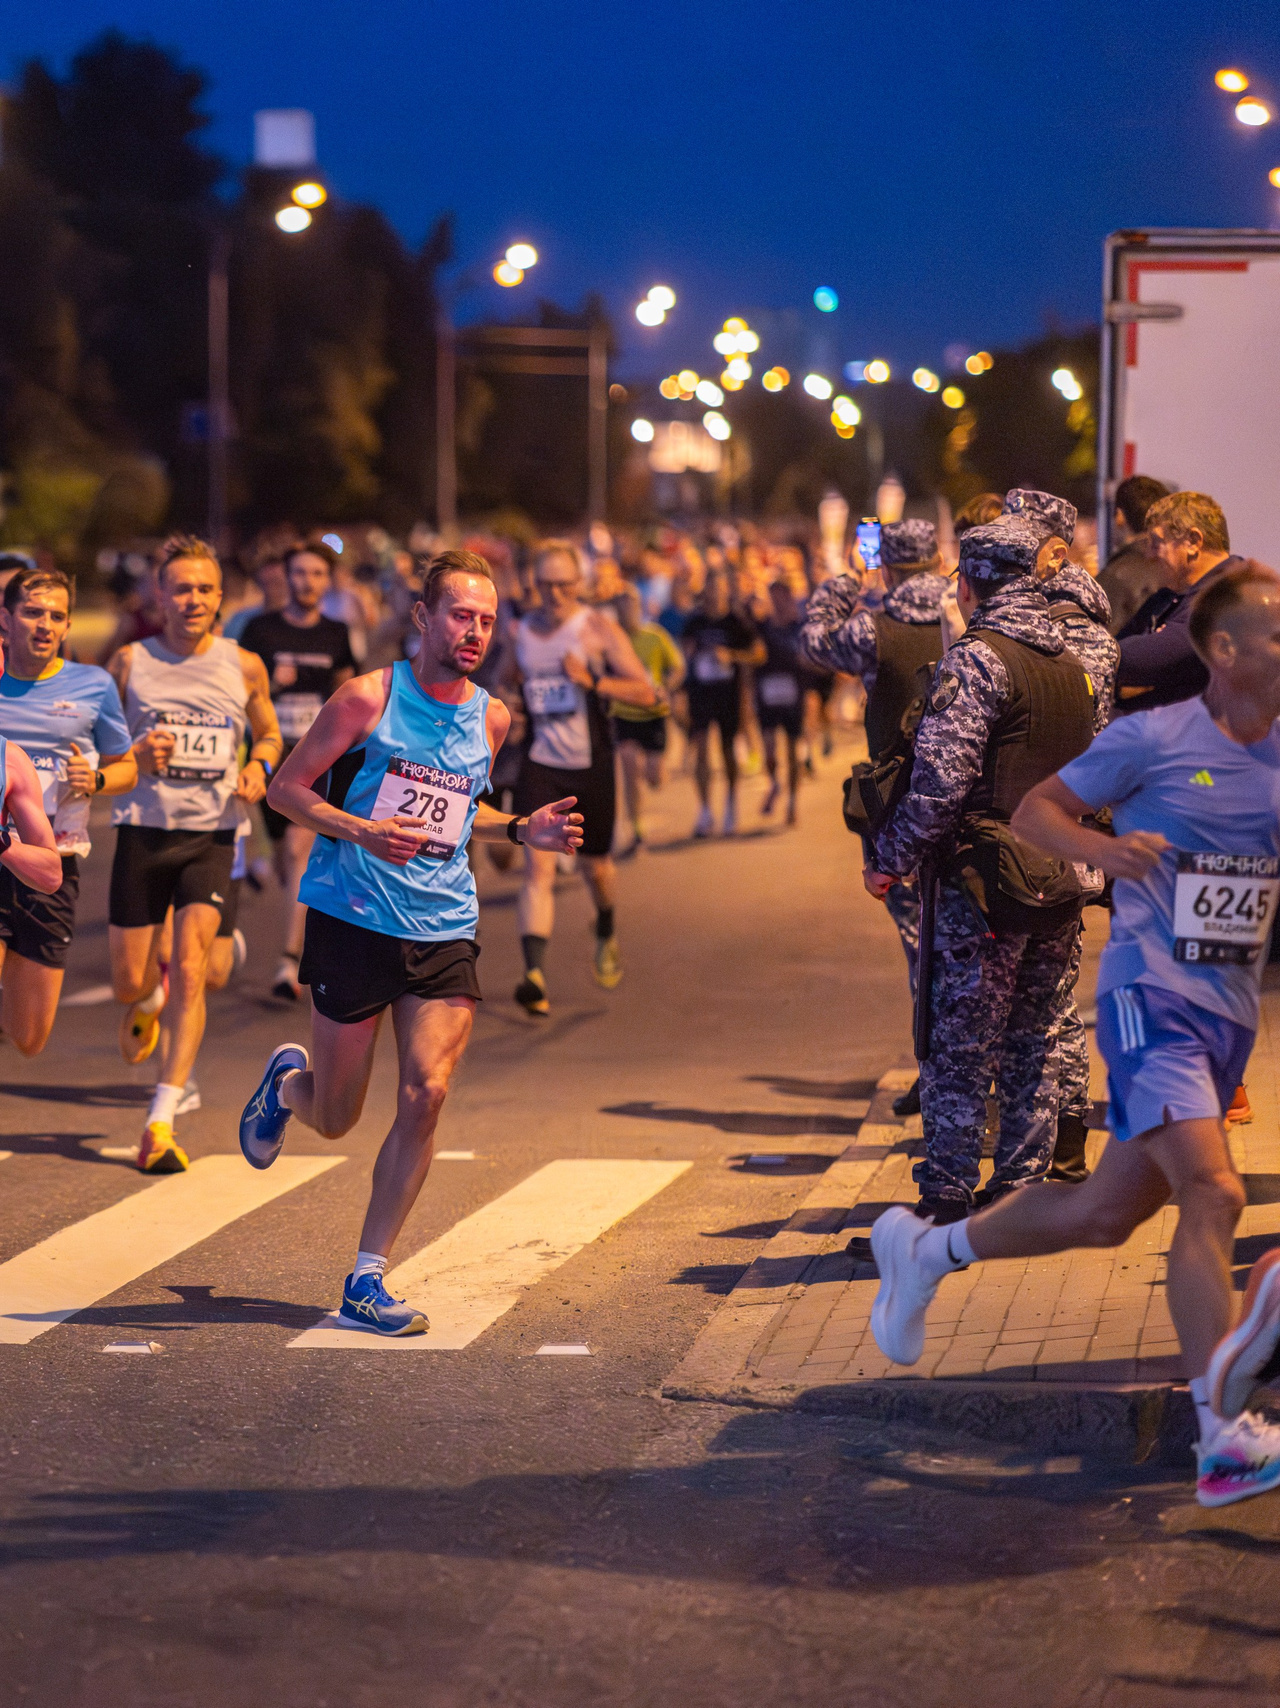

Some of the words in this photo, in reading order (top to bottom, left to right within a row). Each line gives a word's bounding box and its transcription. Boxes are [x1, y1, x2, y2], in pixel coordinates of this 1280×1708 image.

[169, 731, 217, 755] 141
[401, 760, 468, 790] НОЧНОЙ
[397, 788, 449, 823] 278
[1193, 885, 1270, 922] 6245
